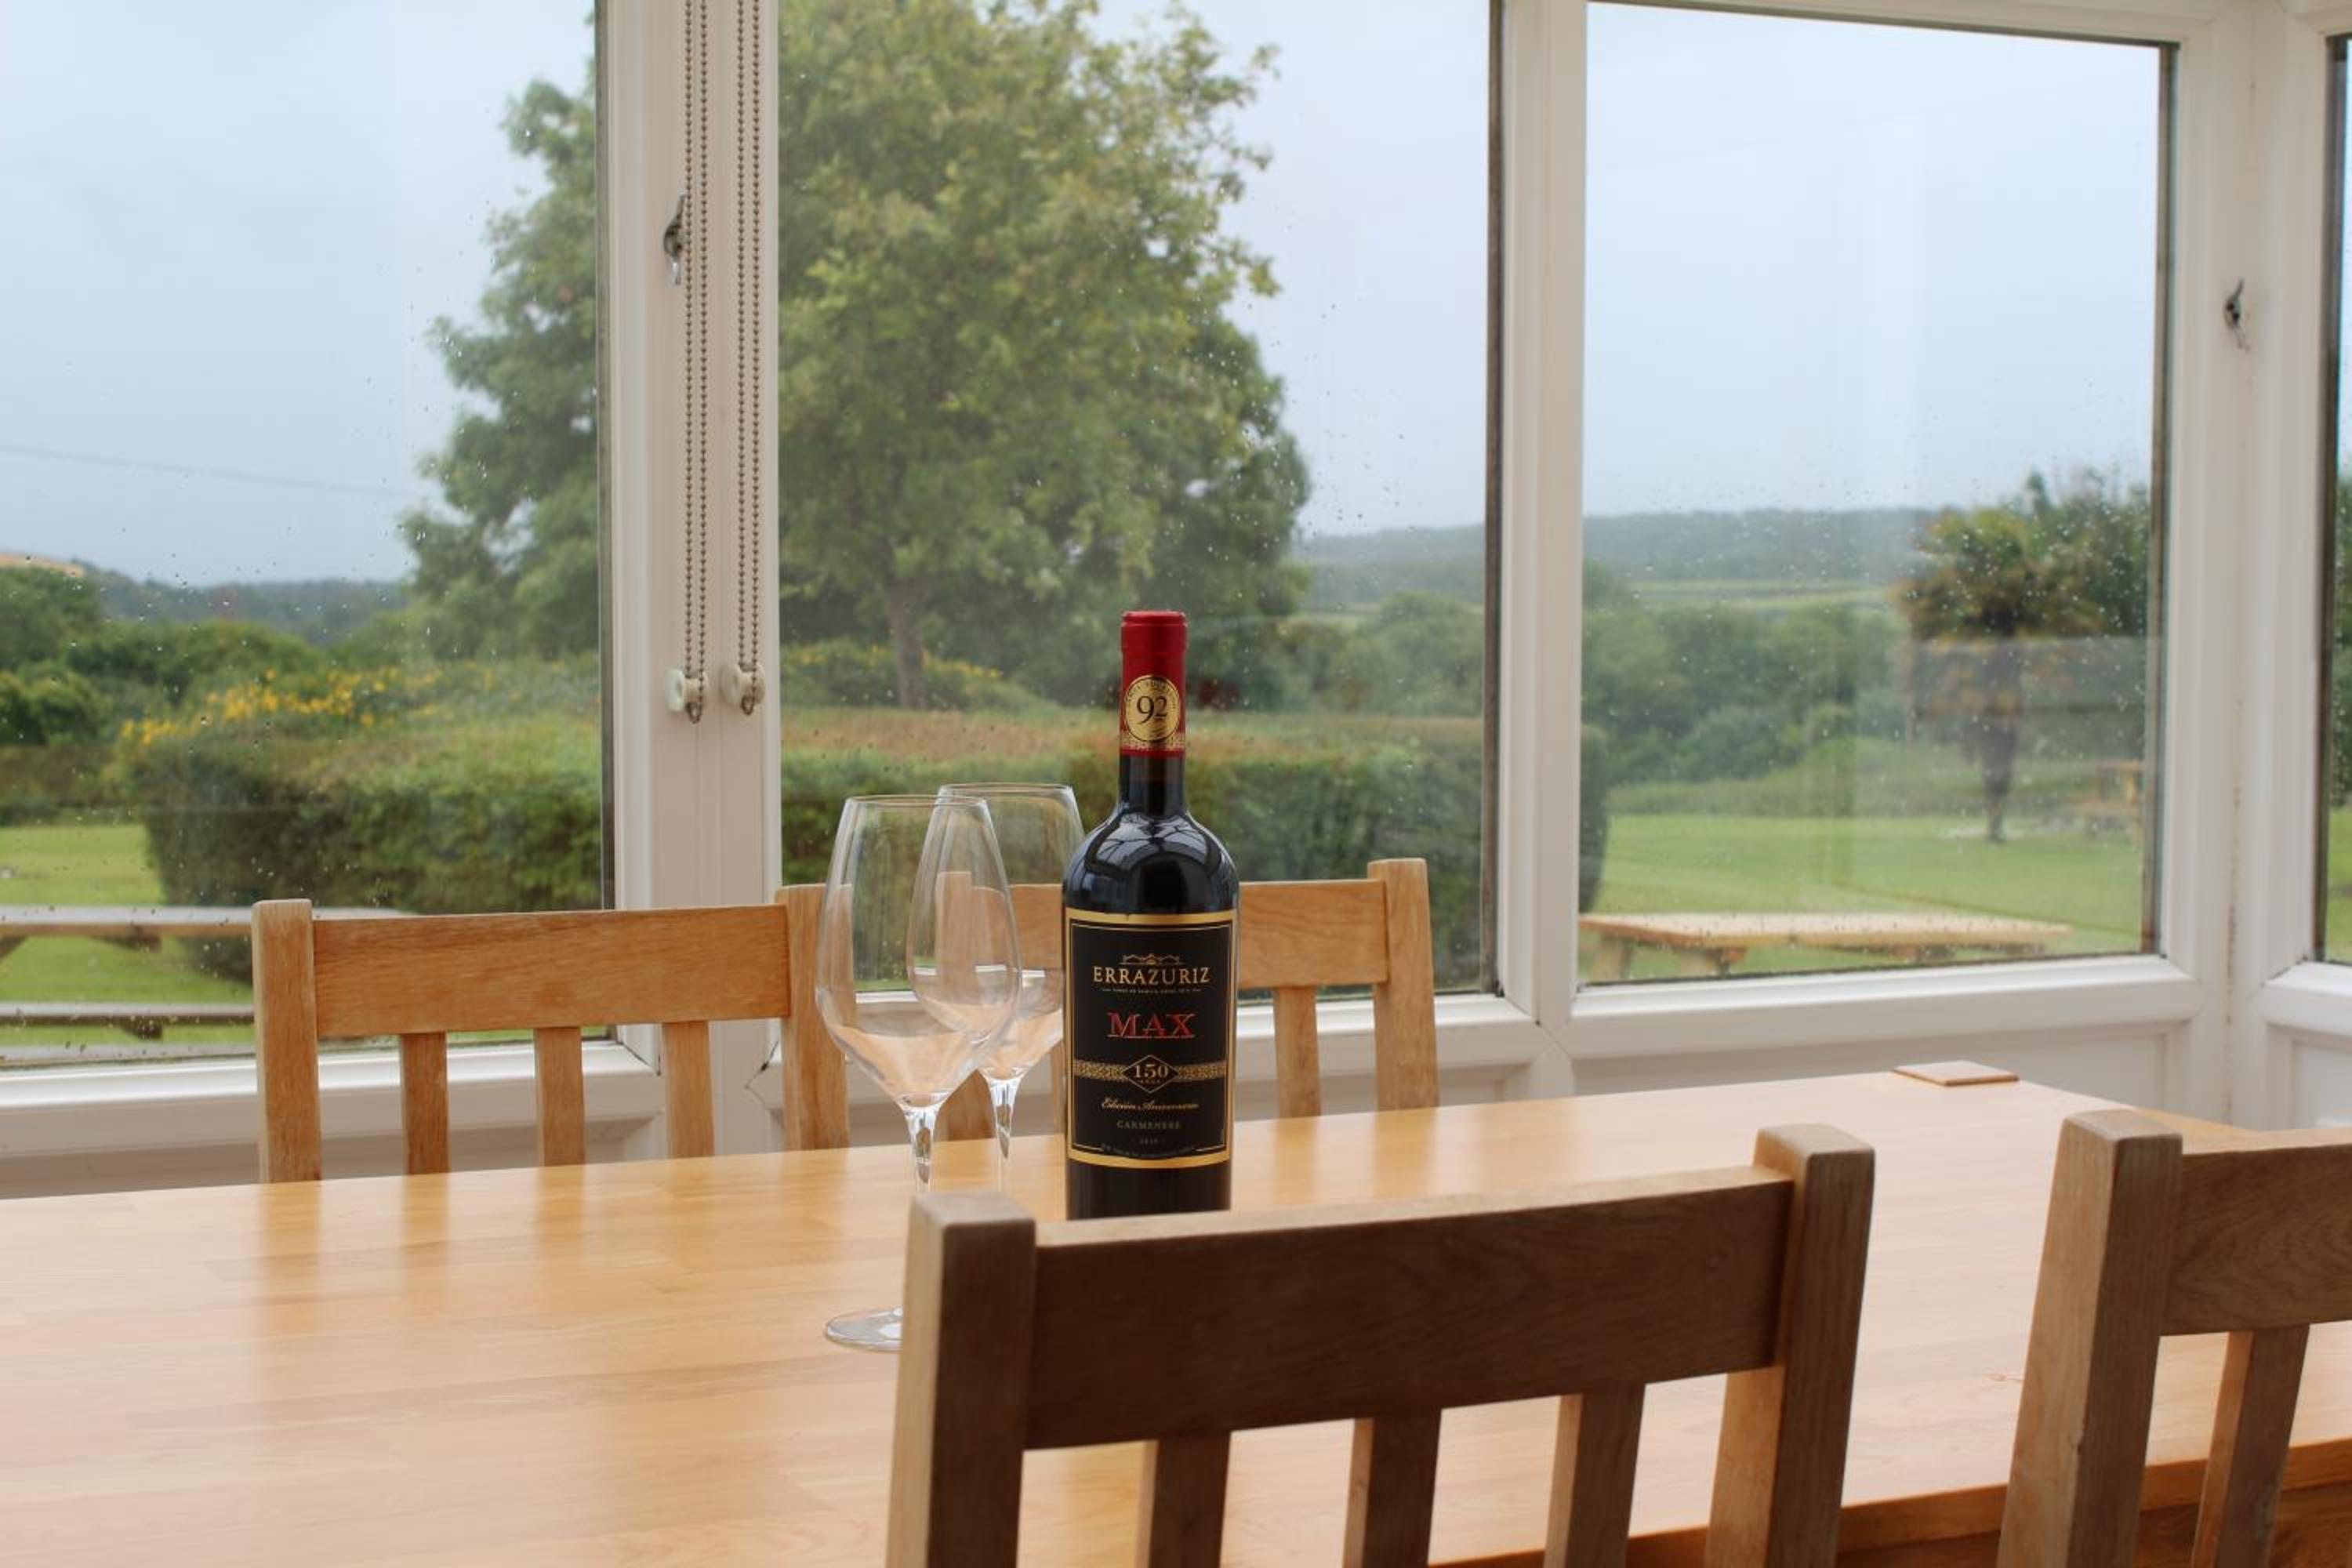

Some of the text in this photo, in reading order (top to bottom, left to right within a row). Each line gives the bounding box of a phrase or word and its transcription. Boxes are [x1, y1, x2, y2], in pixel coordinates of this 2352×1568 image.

[1136, 695, 1168, 724] 92
[1093, 967, 1210, 985] ERRAZURIZ
[1106, 1011, 1196, 1039] MAX
[1134, 1063, 1169, 1080] 150
